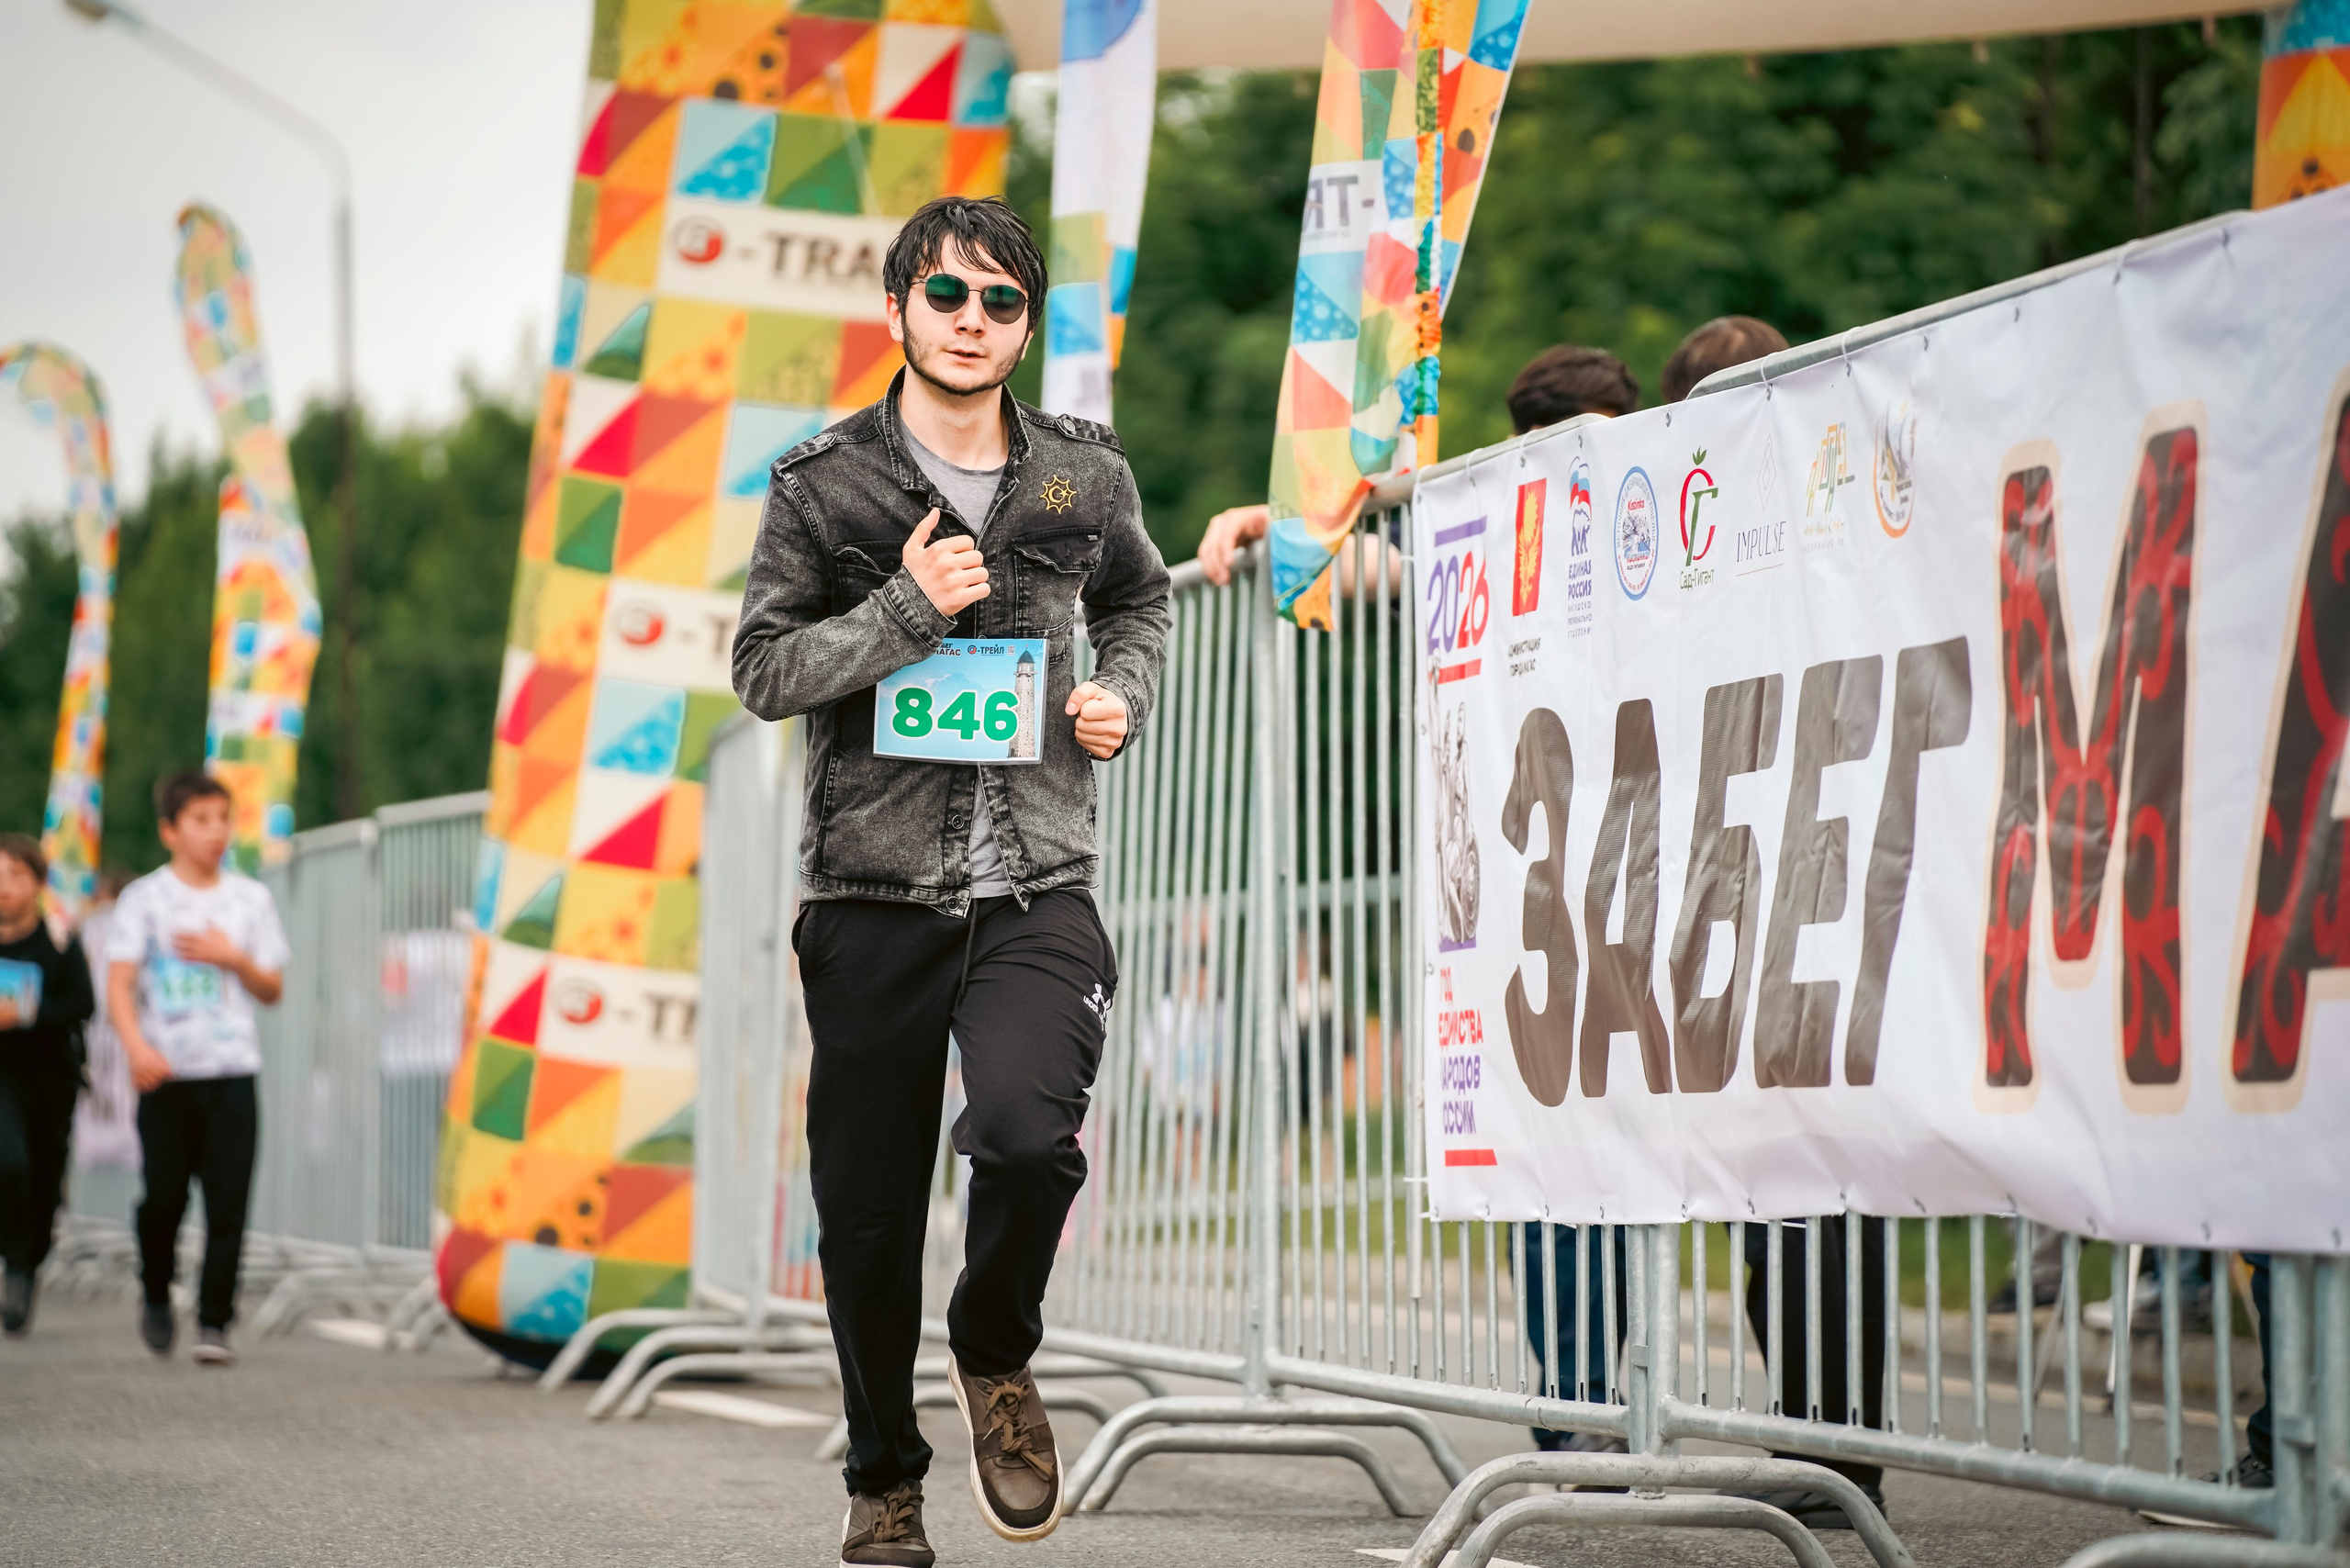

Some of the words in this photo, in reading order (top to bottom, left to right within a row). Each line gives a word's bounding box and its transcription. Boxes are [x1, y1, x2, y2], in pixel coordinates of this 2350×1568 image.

[1737, 521, 1787, 563] IMPULSE
[1567, 579, 1592, 600] РОССИЯ
[1568, 559, 1592, 581] ЕДИНАЯ
[1679, 567, 1715, 591] Сад-Гигант
[1427, 549, 1489, 656] 2026
[891, 687, 1019, 742] 846
[1501, 634, 1973, 1108] ЗАБЕГ
[1441, 1055, 1481, 1095] АРОДОВ
